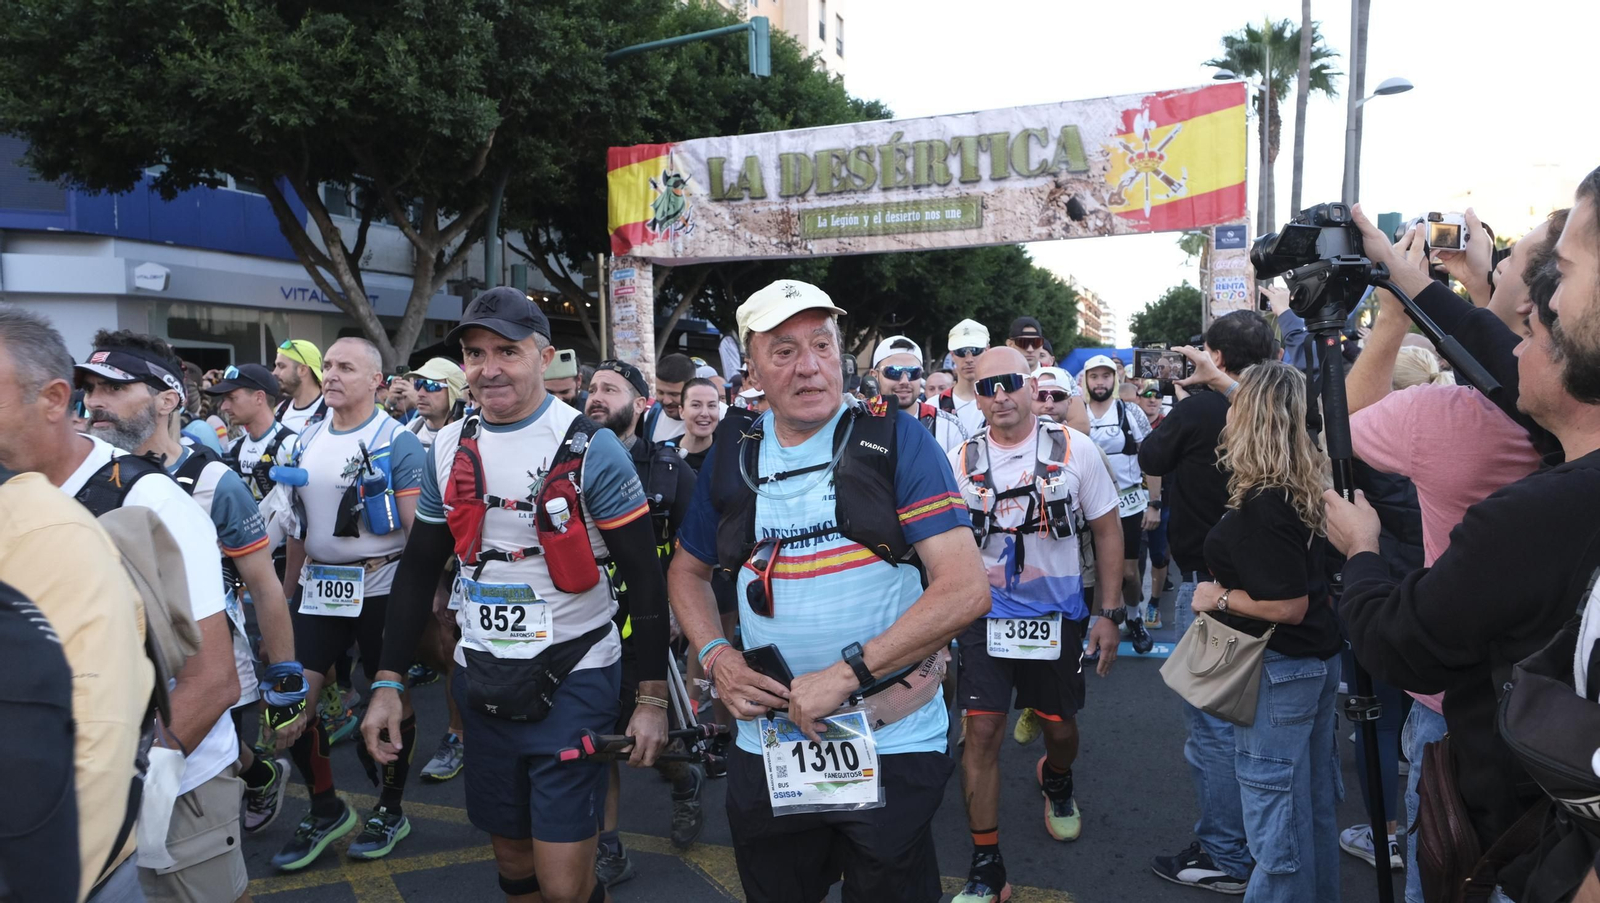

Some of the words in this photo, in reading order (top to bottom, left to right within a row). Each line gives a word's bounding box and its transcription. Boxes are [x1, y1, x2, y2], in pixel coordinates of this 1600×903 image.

[706, 155, 767, 200] LA
[778, 123, 1089, 198] DESÉRTICA
[817, 214, 827, 228] La
[830, 212, 858, 229] Legión
[862, 213, 869, 228] y
[873, 212, 882, 224] el
[885, 208, 920, 224] desierto
[924, 210, 940, 220] nos
[945, 208, 962, 220] une
[280, 286, 379, 306] VITALT
[1216, 282, 1245, 290] RENTA
[859, 440, 888, 454] EVADICT
[316, 580, 354, 599] 1809
[480, 605, 526, 632] 852
[1005, 620, 1050, 640] 3829
[792, 741, 860, 773] 1310
[774, 791, 797, 799] asisa
